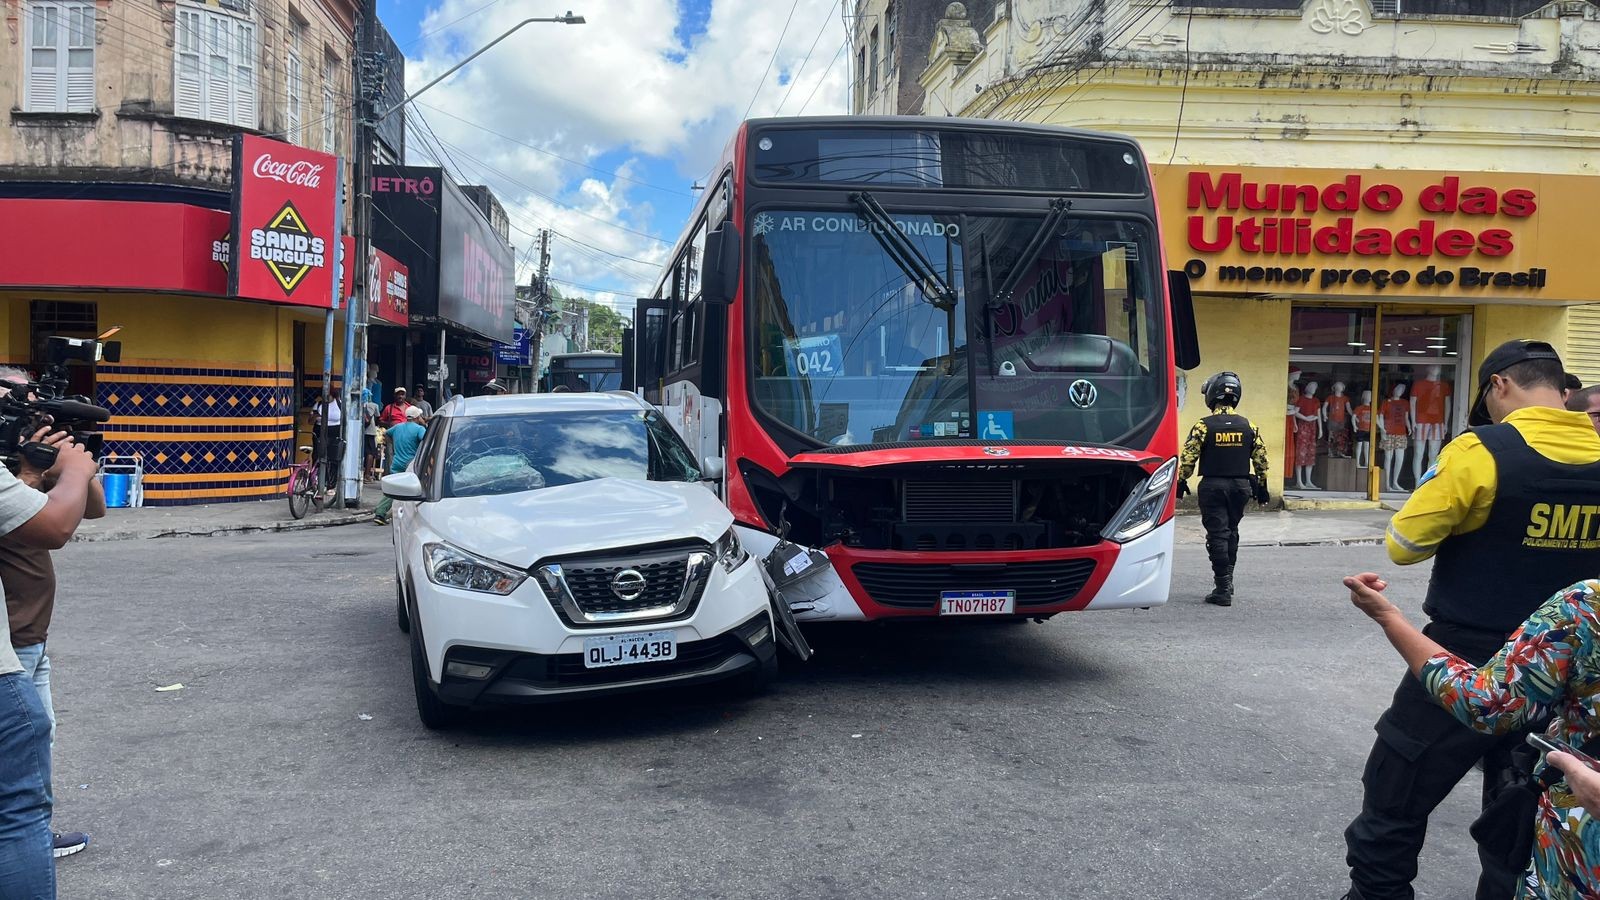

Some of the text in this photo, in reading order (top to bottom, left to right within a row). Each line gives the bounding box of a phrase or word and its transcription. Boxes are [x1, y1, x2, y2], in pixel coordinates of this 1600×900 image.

[253, 154, 324, 188] Coca-Cola
[1187, 172, 1537, 217] Mundo das
[780, 217, 805, 231] AR
[1187, 216, 1514, 257] Utilidades
[251, 229, 324, 254] SAND'S
[251, 246, 324, 267] BURGUER
[1184, 258, 1547, 290] O menor preço do Brasil
[797, 350, 833, 375] 042
[1215, 432, 1243, 443] DMTT
[1527, 503, 1600, 540] SMT
[1522, 537, 1568, 548] POLICIAMENTO
[1568, 540, 1579, 549] DE
